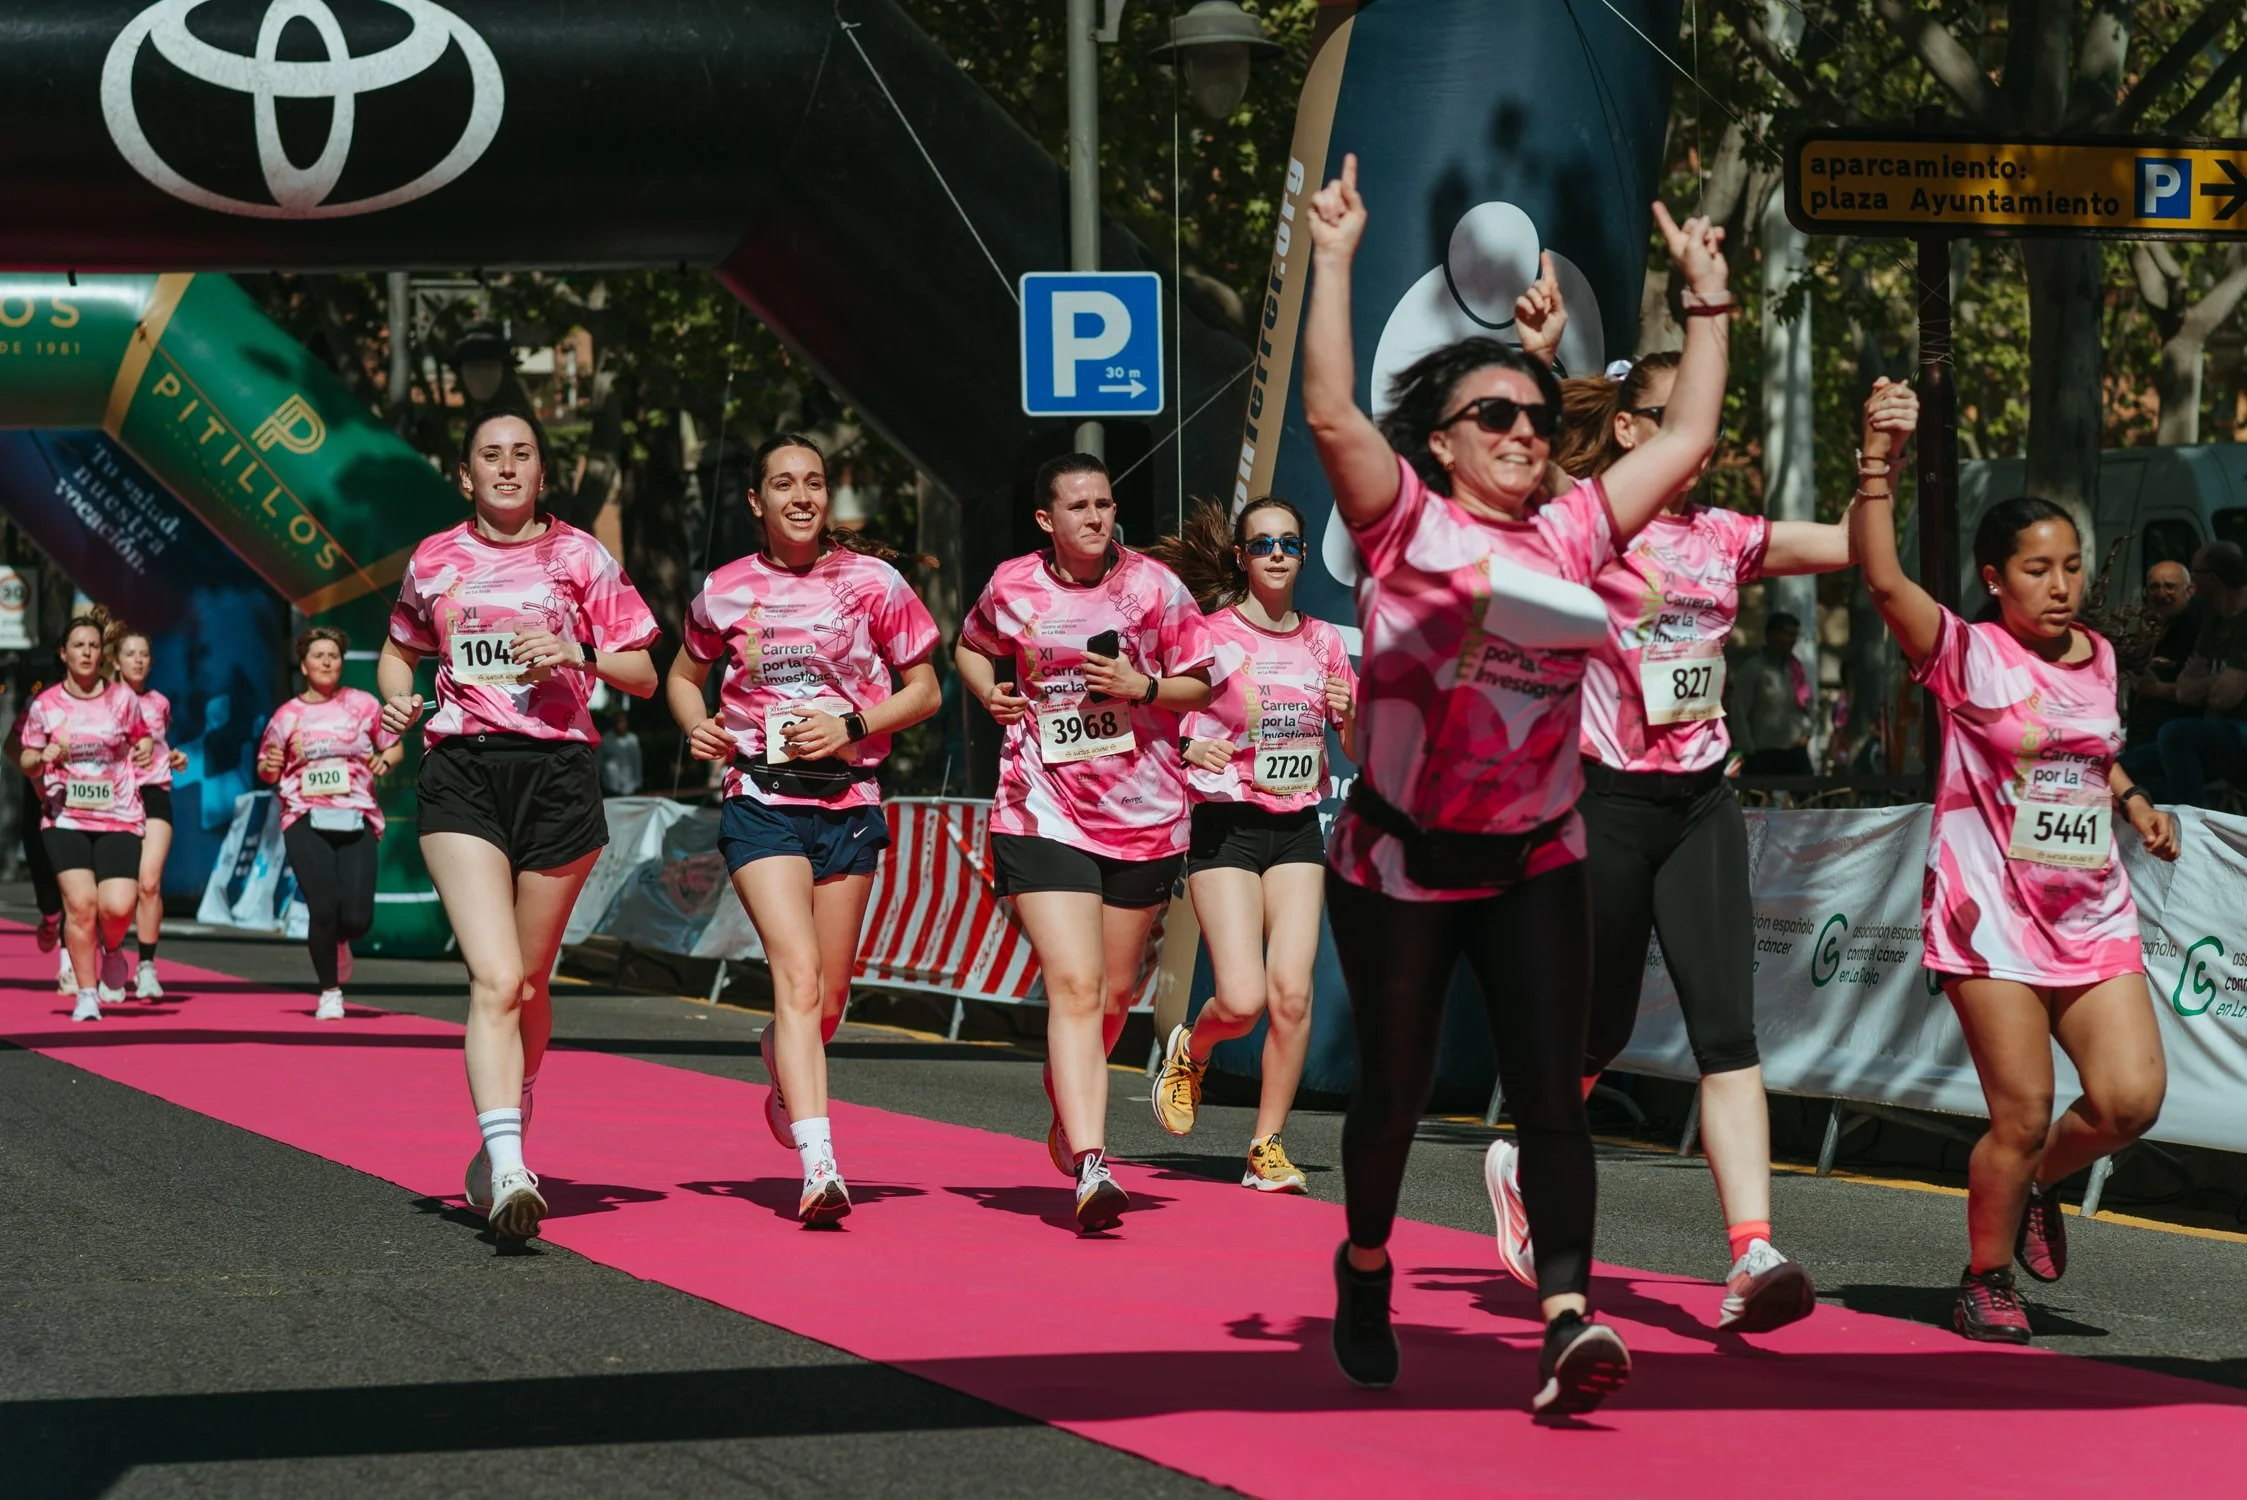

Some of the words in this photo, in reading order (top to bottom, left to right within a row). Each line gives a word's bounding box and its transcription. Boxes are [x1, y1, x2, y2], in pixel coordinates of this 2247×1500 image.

[1810, 154, 2027, 182] aparcamiento:
[2144, 163, 2182, 214] P
[1810, 185, 1889, 214] plaza
[1910, 187, 2120, 217] Ayuntamiento
[1051, 290, 1132, 398] P
[1105, 366, 1125, 379] 30
[1129, 368, 1141, 378] m
[152, 372, 341, 571] PITILLOS
[72, 465, 165, 556] nuestra
[1664, 590, 1714, 609] Carrera
[1657, 613, 1681, 630] por
[1682, 611, 1694, 627] la
[761, 627, 775, 640] XI
[460, 639, 517, 667] 104
[761, 643, 815, 656] Carrera
[1039, 647, 1054, 661] XI
[763, 661, 786, 675] por
[787, 658, 802, 670] la
[1041, 665, 1082, 678] Carre
[1044, 683, 1069, 695] por
[1070, 681, 1086, 693] la
[1258, 685, 1271, 696] XI
[1672, 666, 1712, 700] 827
[1261, 699, 1309, 712] Carrera
[1052, 711, 1118, 745] 3968
[1262, 717, 1283, 730] por
[1284, 715, 1296, 727] la
[2045, 727, 2063, 743] XI
[1266, 754, 1313, 779] 2720
[2039, 747, 2105, 768] Carrera
[308, 770, 341, 787] 9120
[2033, 768, 2061, 785] por
[2064, 767, 2079, 785] la
[71, 783, 111, 799] 10516
[2033, 811, 2098, 845] 5441
[1772, 917, 1815, 936] española
[1891, 924, 1922, 942] españo
[1757, 936, 1792, 956] cáncer
[1877, 946, 1909, 964] cáncer
[2216, 1002, 2233, 1017] en
